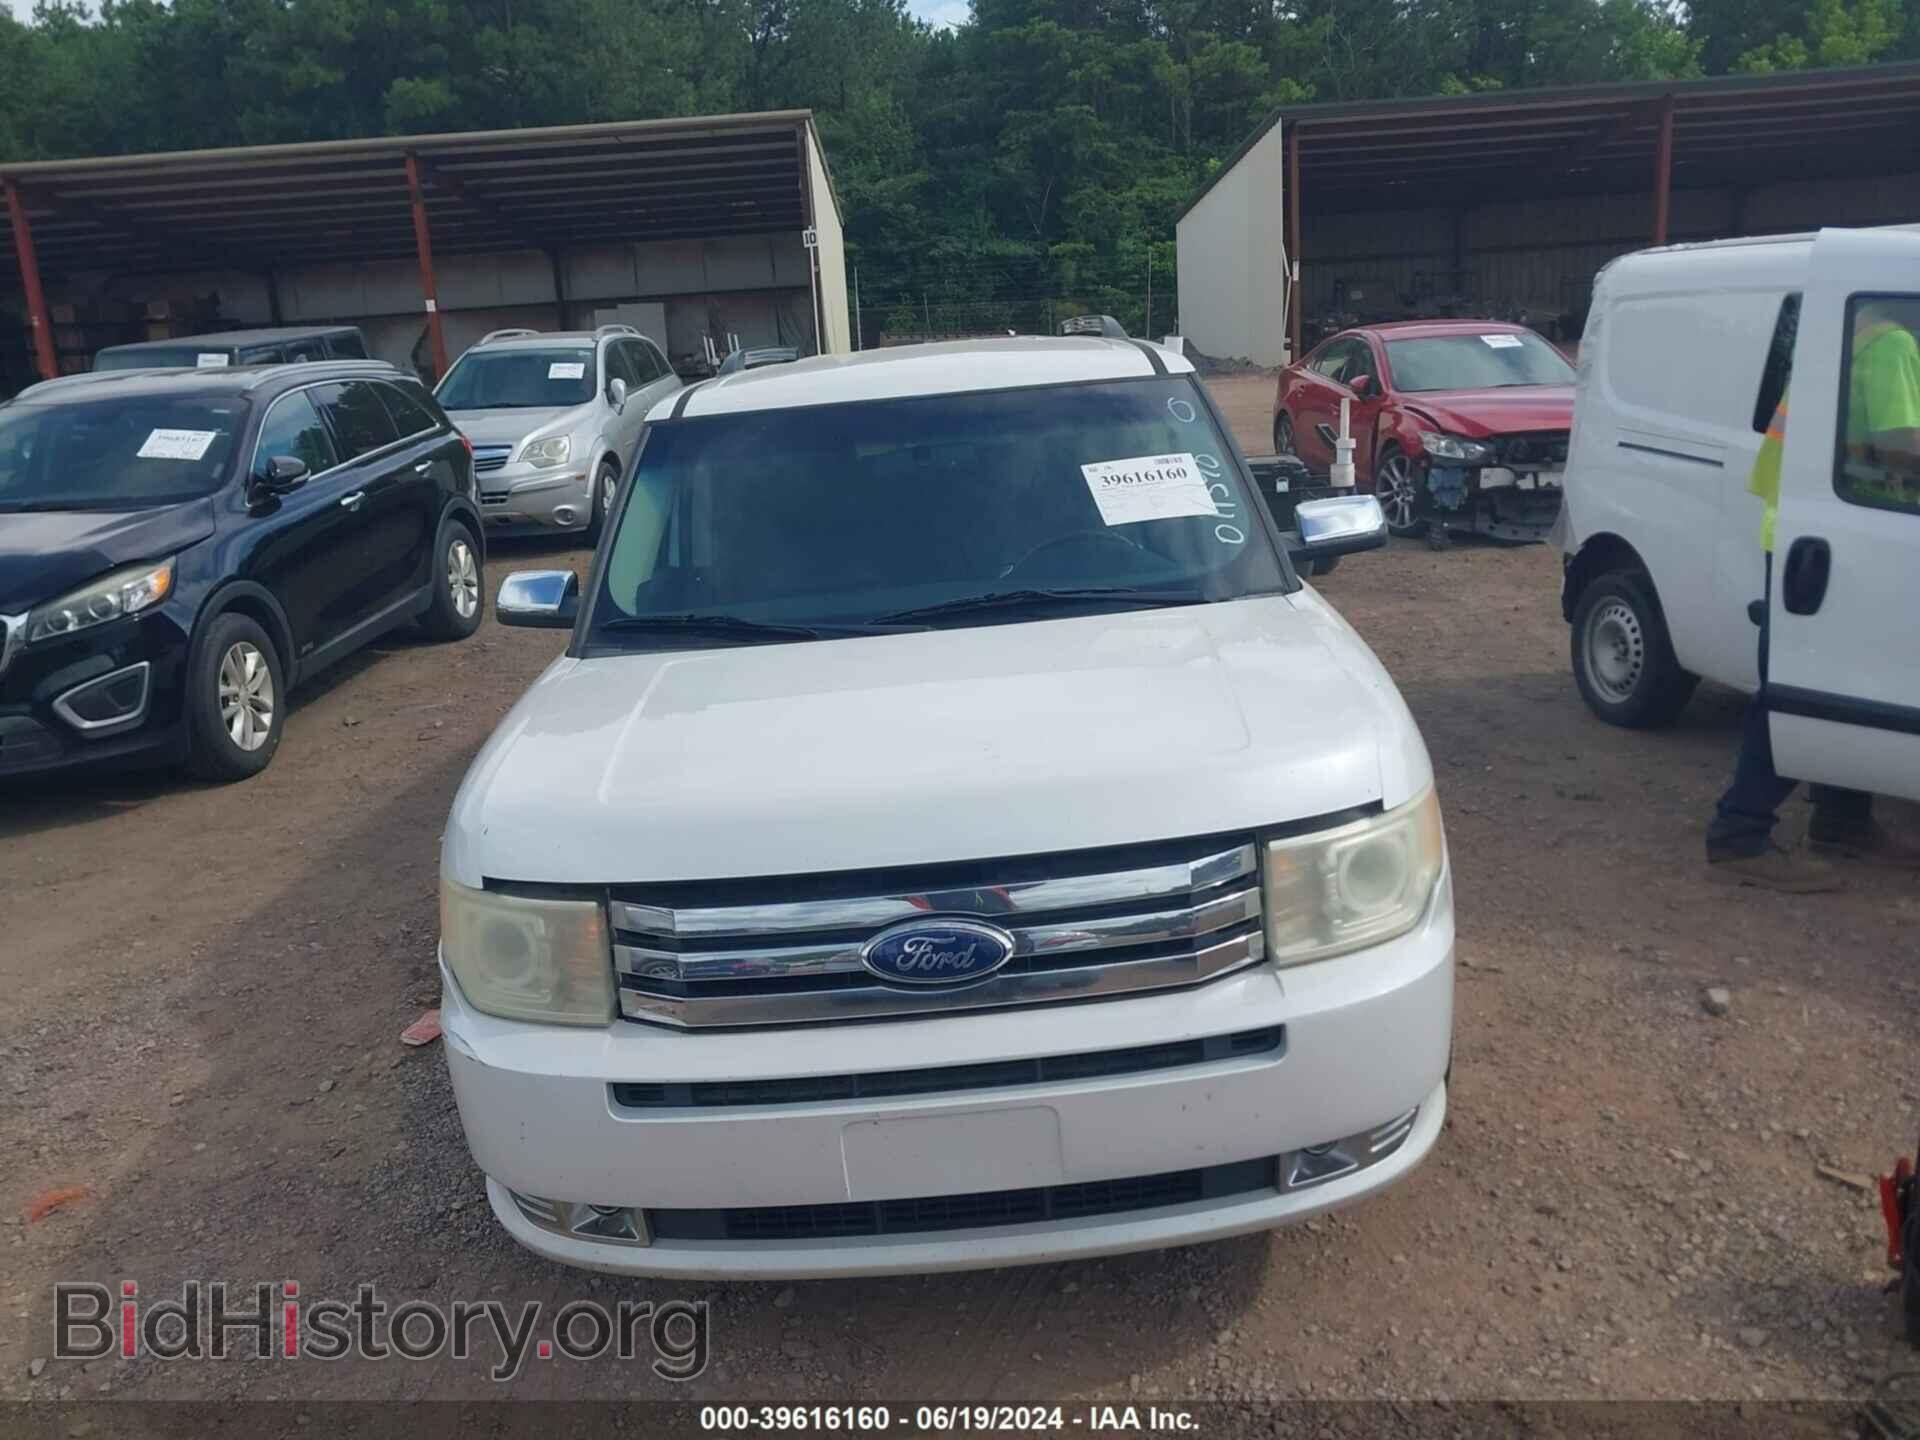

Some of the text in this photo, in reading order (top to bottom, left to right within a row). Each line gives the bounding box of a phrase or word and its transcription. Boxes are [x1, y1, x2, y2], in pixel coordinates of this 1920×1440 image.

[804, 231, 817, 245] 10
[1100, 466, 1188, 488] 39616160
[895, 935, 977, 971] Ford
